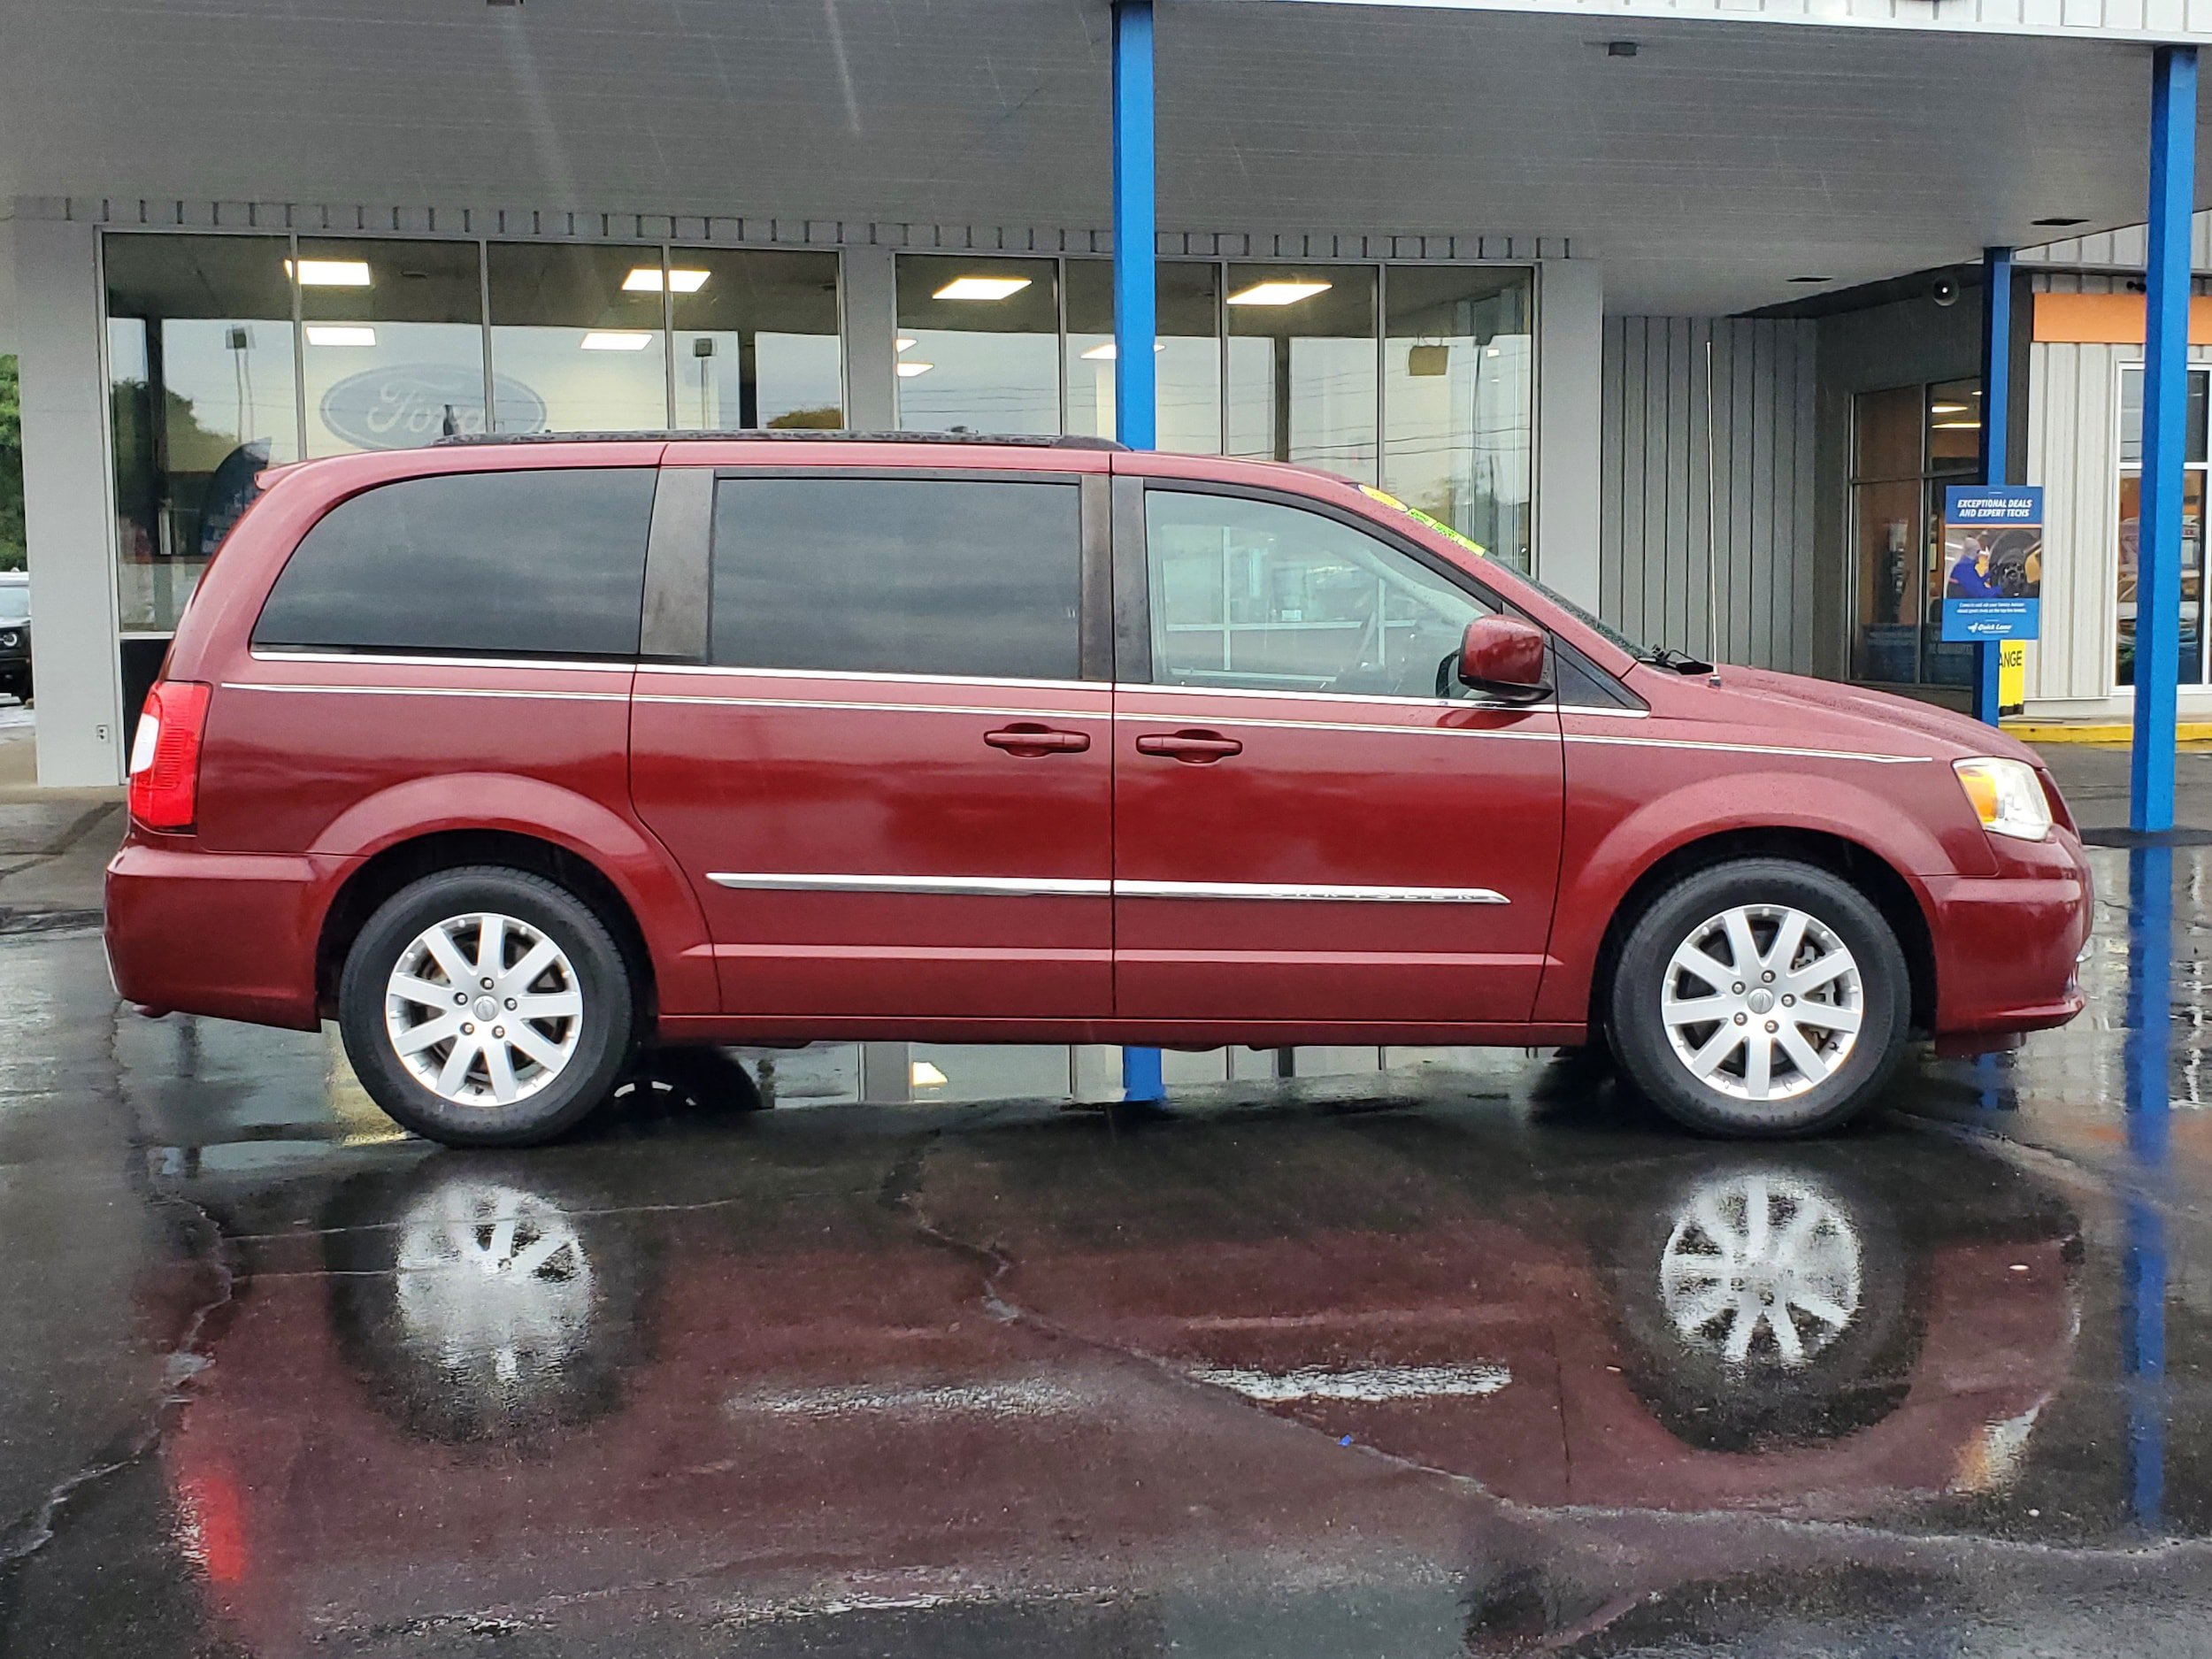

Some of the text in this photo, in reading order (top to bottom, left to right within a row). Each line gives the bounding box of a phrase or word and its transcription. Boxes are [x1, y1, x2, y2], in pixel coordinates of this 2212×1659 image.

[1957, 499, 2033, 508] EXCEPTIONAL DEALS
[1958, 509, 2030, 518] AND EXPERT TECHS
